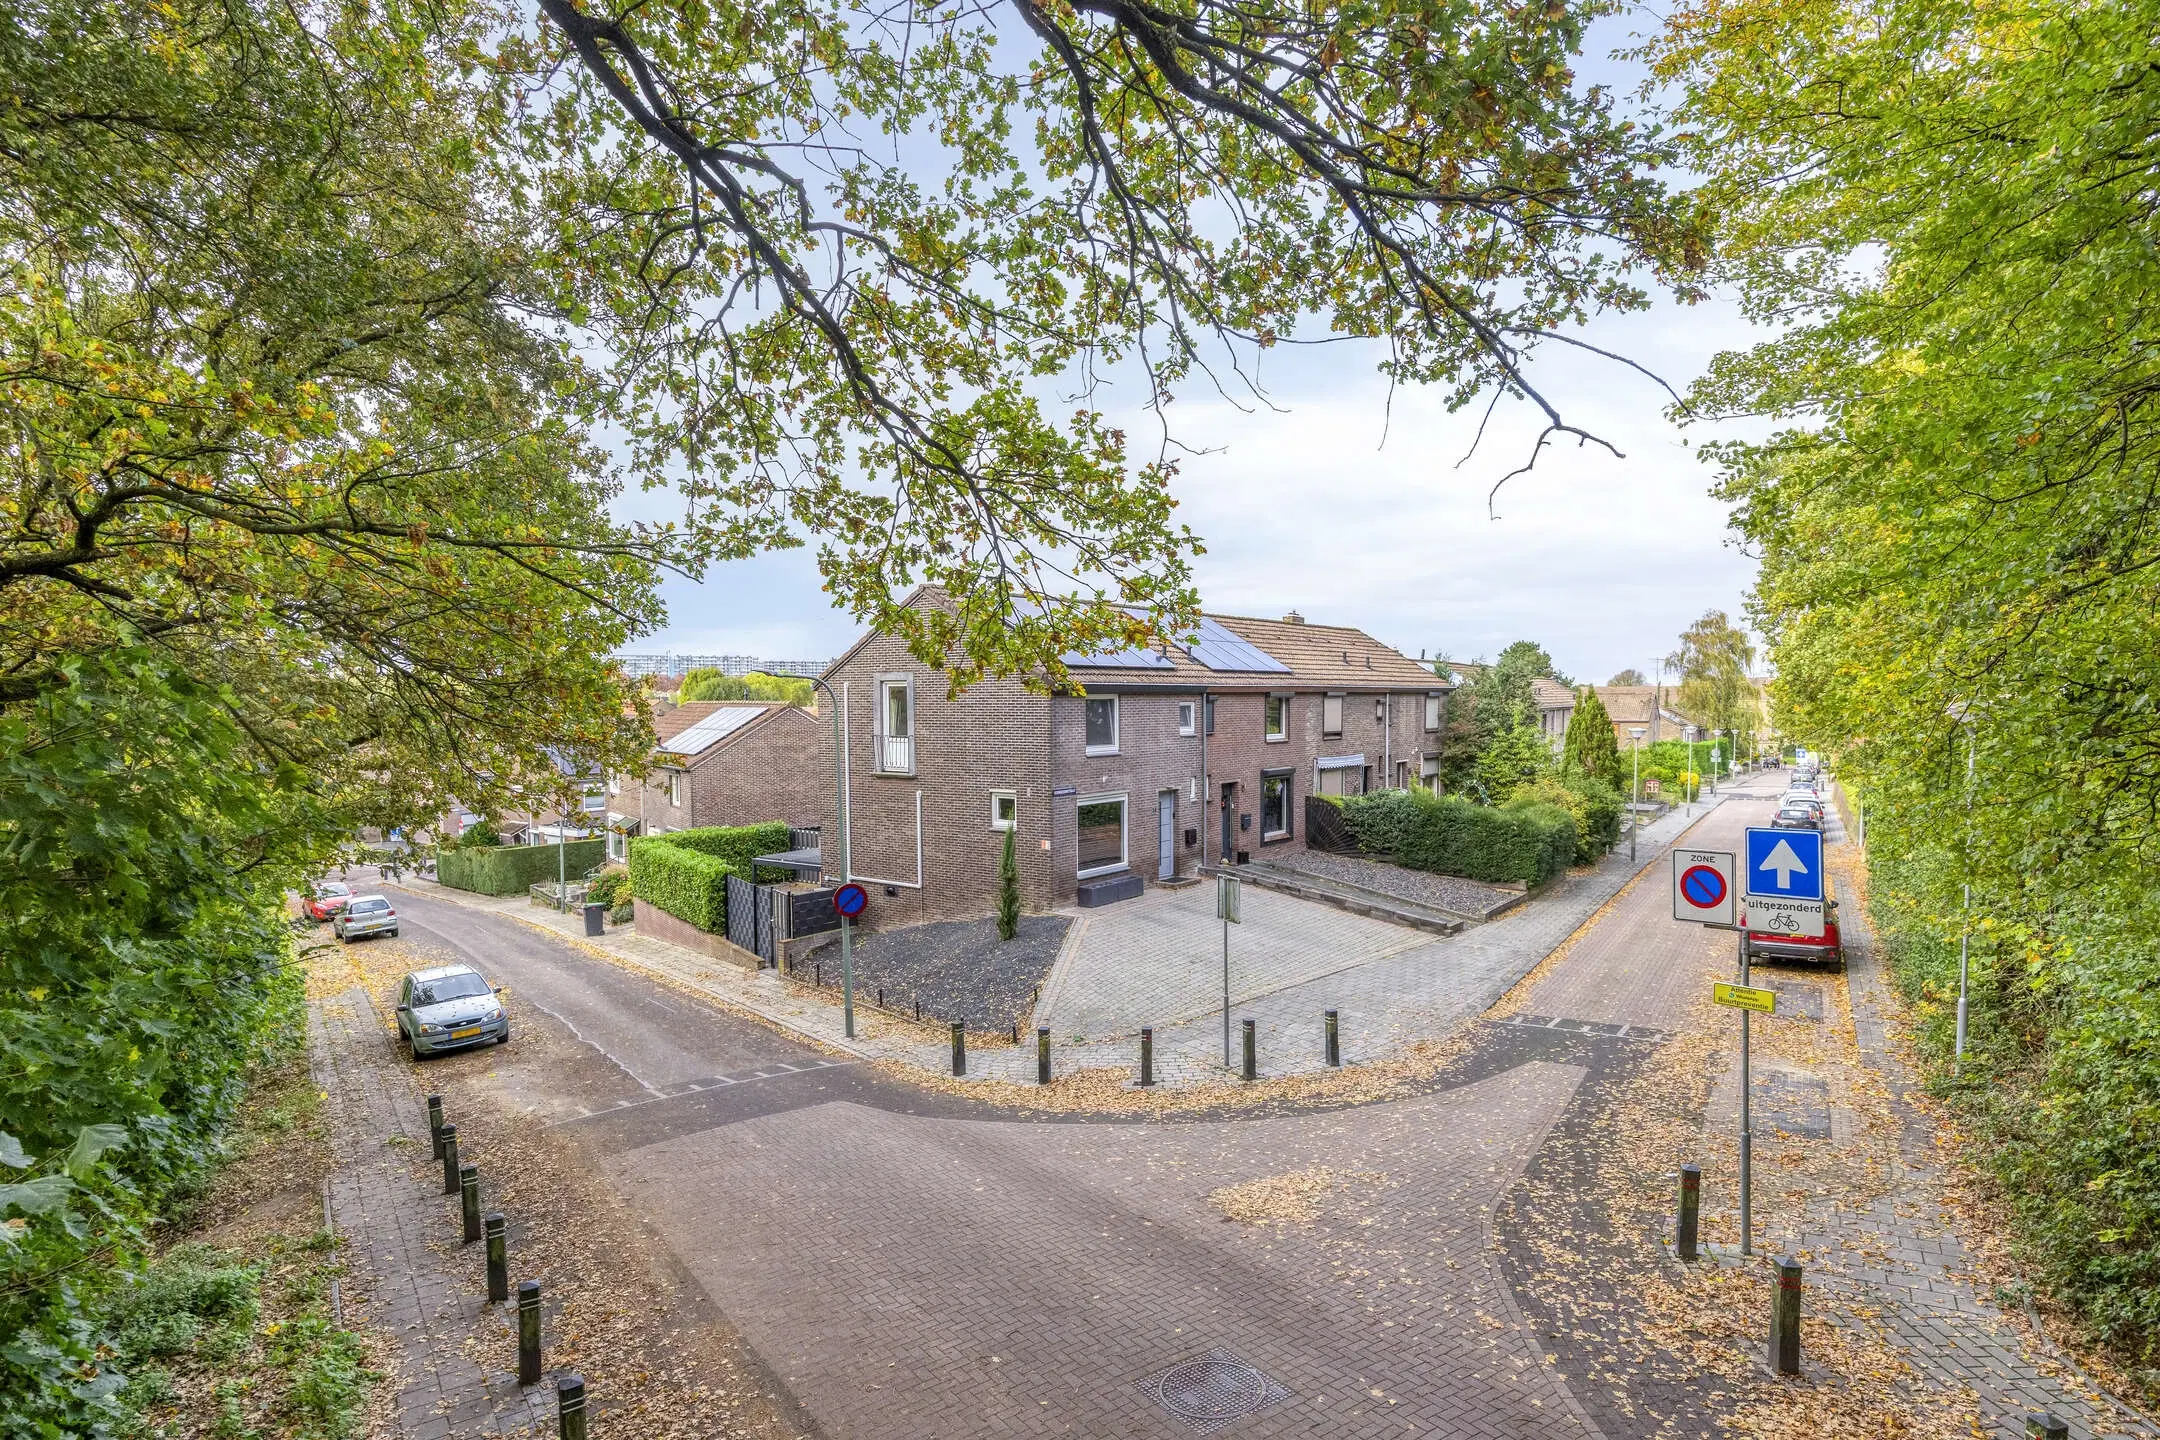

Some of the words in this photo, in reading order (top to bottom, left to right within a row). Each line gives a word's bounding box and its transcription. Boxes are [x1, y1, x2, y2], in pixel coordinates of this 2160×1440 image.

[1690, 854, 1716, 863] ZONE
[1748, 900, 1822, 913] uitgezonderd
[1730, 986, 1757, 996] Attentie
[1718, 996, 1769, 1010] Buurtpreventie
